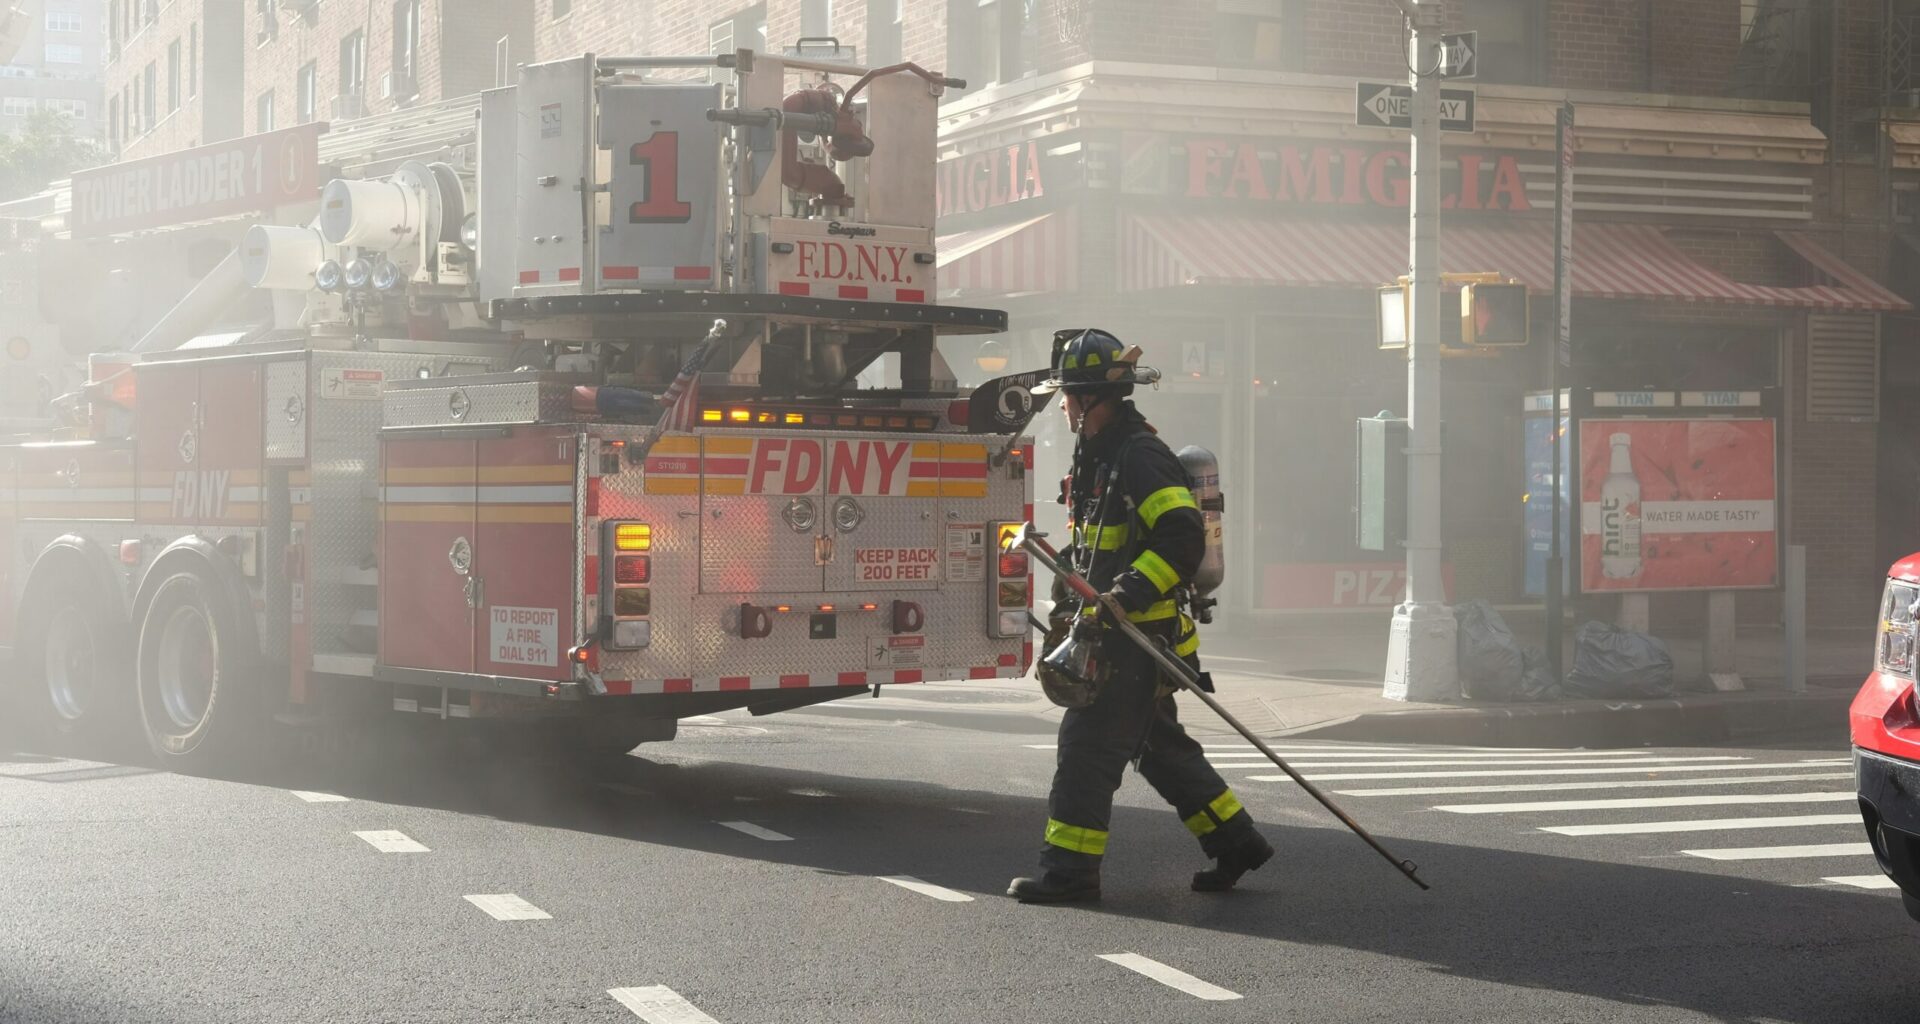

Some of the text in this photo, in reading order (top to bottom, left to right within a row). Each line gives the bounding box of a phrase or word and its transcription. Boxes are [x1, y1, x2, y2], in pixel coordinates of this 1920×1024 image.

[1376, 97, 1459, 119] ONE AY
[79, 144, 263, 225] TOWER LADDER 1
[630, 131, 691, 223] 1
[796, 240, 912, 284] F.D.N.Y.
[1615, 393, 1654, 405] TITAN
[1702, 392, 1741, 405] TITAN
[751, 438, 910, 495] FDNY
[172, 470, 229, 518] FDNY
[1603, 496, 1619, 556] hint
[1646, 511, 1682, 522] WATER
[1686, 511, 1720, 522] MADE
[856, 549, 937, 564] KEEP BACK
[863, 565, 931, 580] 200 FEET
[1333, 570, 1407, 605] PIZ
[493, 608, 555, 626] TO REPORT
[506, 628, 541, 643] A FIRE
[499, 646, 547, 663] DIAL 911
